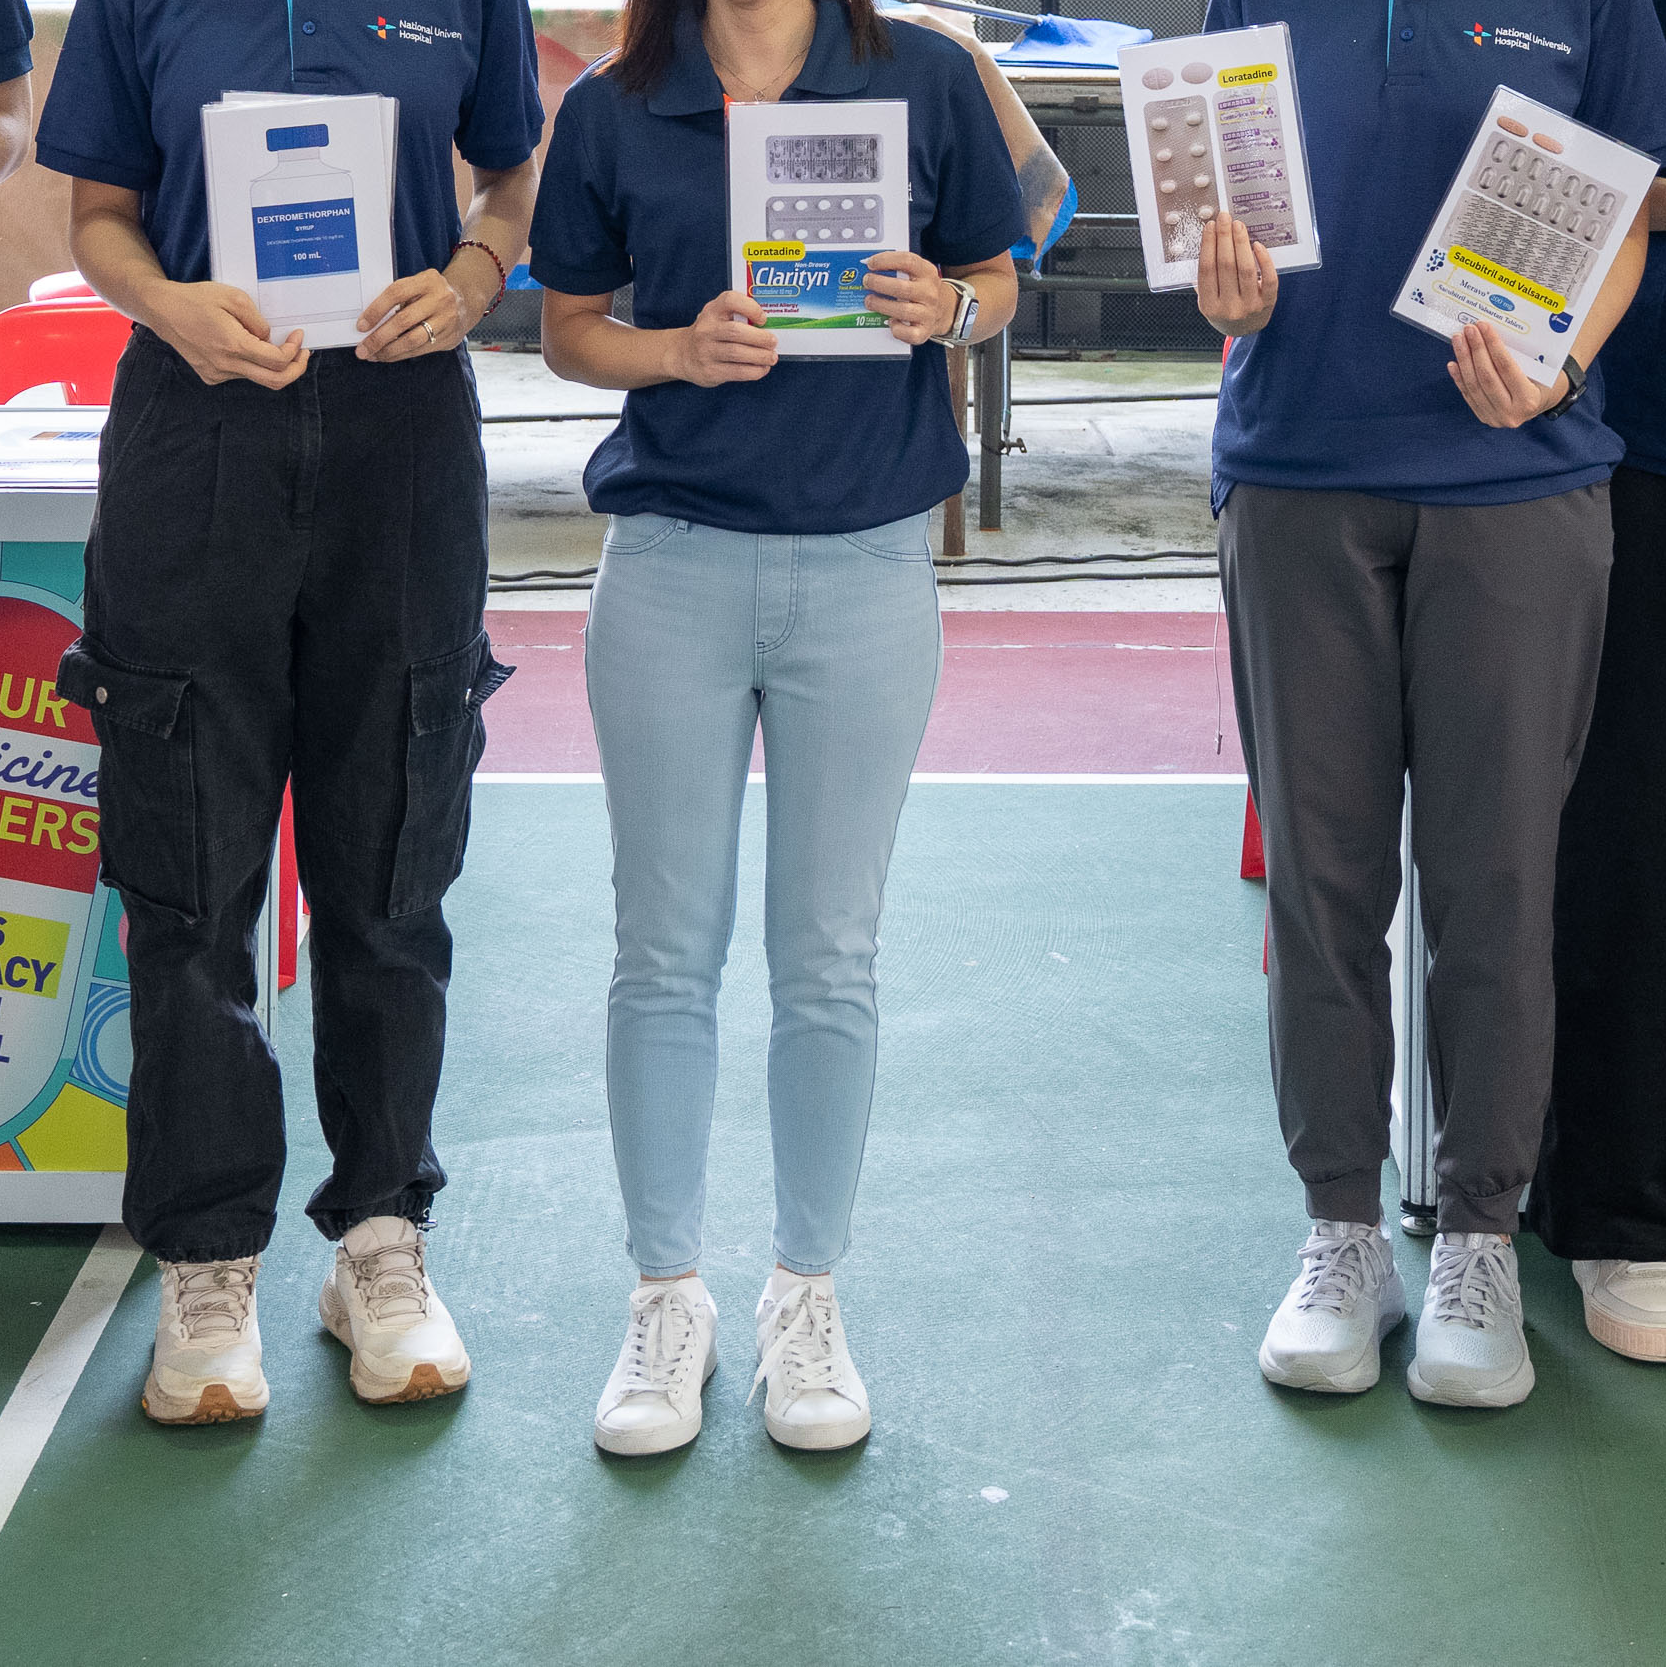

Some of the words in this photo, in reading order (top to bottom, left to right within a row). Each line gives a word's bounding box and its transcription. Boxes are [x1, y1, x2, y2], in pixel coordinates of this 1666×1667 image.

[399, 19, 433, 35] National
[399, 30, 432, 44] Hospital
[1494, 36, 1530, 51] Hospital
[1495, 27, 1532, 42] National
[1532, 34, 1572, 55] University
[1222, 68, 1274, 84] Loratadine
[257, 207, 350, 224] DEXTROMETHORPHAN
[295, 224, 314, 232] SYRUP
[293, 253, 307, 261] 100
[308, 251, 321, 259] mL
[747, 246, 801, 256] Loratadine
[755, 267, 830, 291] Clarityn
[841, 270, 856, 279] 24
[1453, 251, 1498, 279] Sacubitril
[1498, 275, 1516, 287] and
[1517, 282, 1559, 309] Valsartan
[1438, 284, 1466, 303] Sacubitril
[1466, 298, 1478, 309] and
[1478, 303, 1504, 321] Valsartan
[1504, 316, 1524, 331] Tablets
[855, 315, 865, 326] 10
